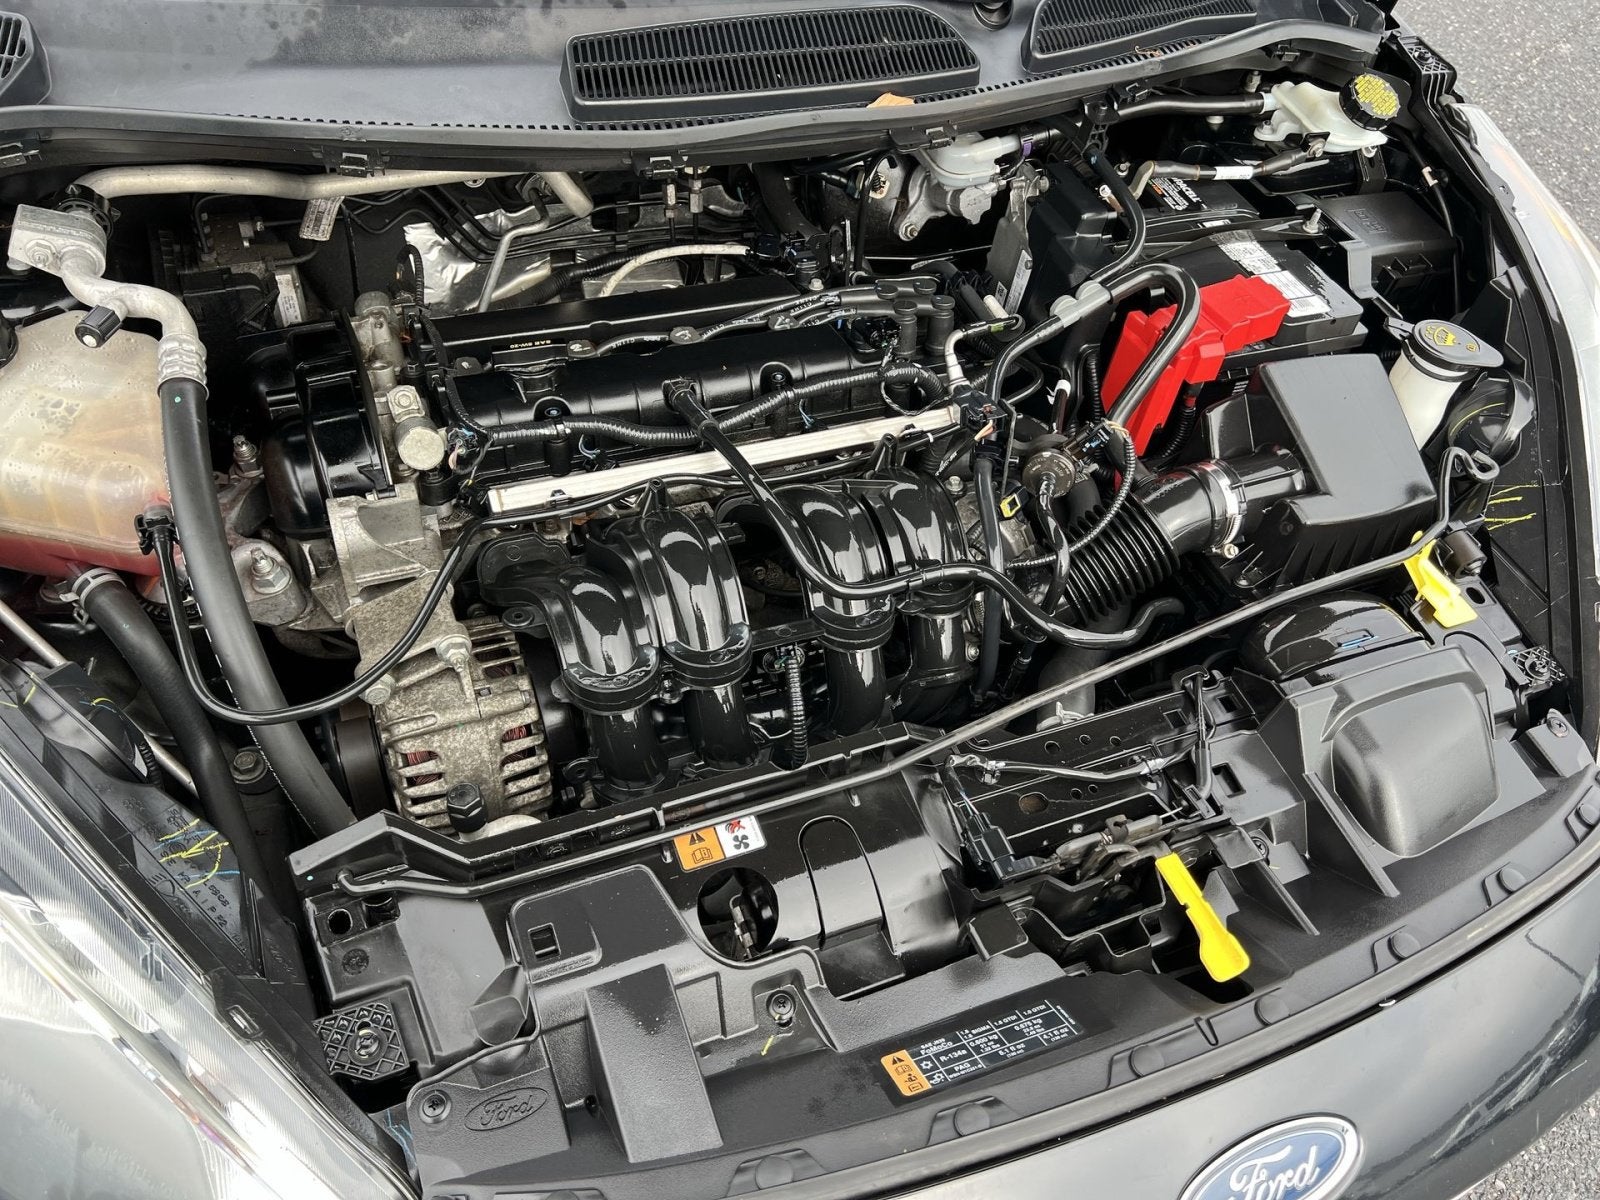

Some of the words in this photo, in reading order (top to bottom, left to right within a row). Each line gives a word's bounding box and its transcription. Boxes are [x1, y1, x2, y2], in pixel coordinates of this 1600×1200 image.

[920, 1041, 953, 1055] FoMoCo
[939, 1049, 967, 1062] R-134a
[953, 1062, 971, 1072] PAG
[480, 1094, 533, 1126] Ford
[1227, 1144, 1321, 1200] Ford
